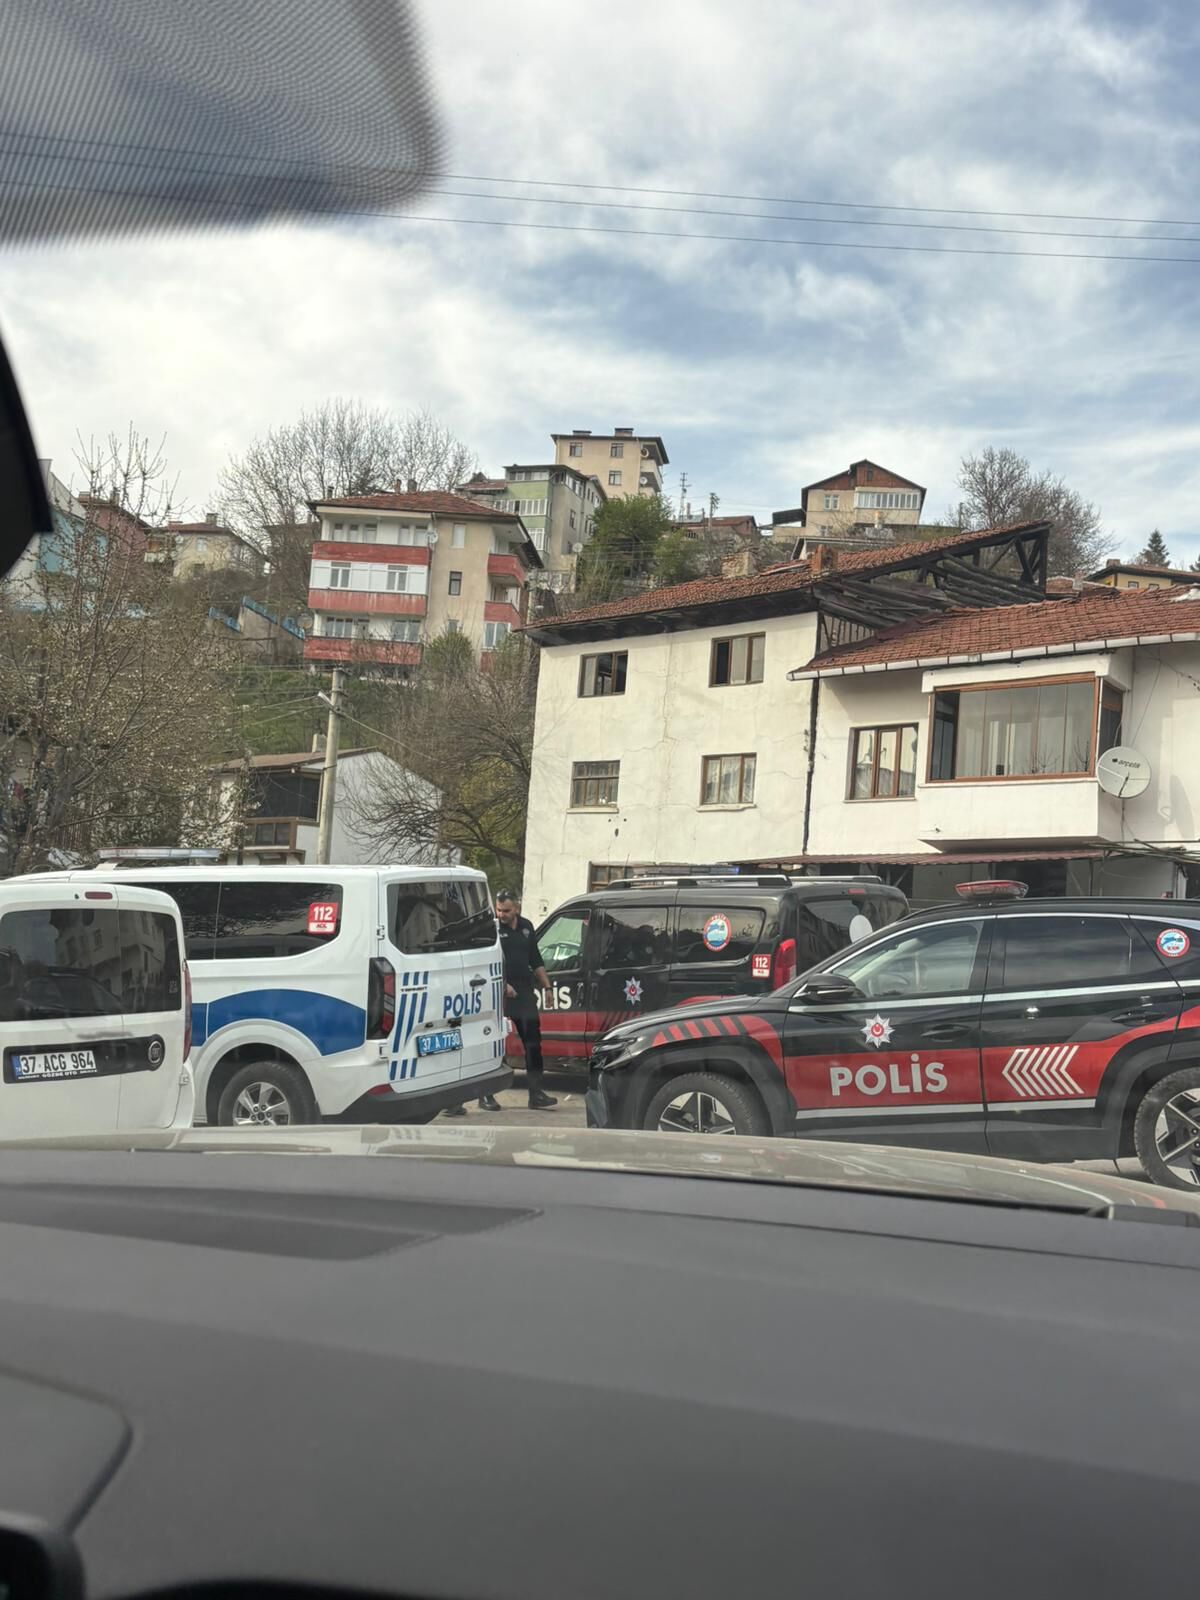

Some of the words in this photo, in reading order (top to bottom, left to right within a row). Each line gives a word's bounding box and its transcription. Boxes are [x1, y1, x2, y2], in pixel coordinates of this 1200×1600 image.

[313, 906, 333, 920] 112
[755, 956, 768, 968] 112
[443, 988, 482, 1018] POLİS
[422, 1037, 431, 1051] 37
[435, 1036, 441, 1049] A
[21, 1056, 36, 1073] 37
[43, 1054, 66, 1072] ACG
[70, 1052, 94, 1069] 964
[829, 1053, 948, 1096] POLİS
